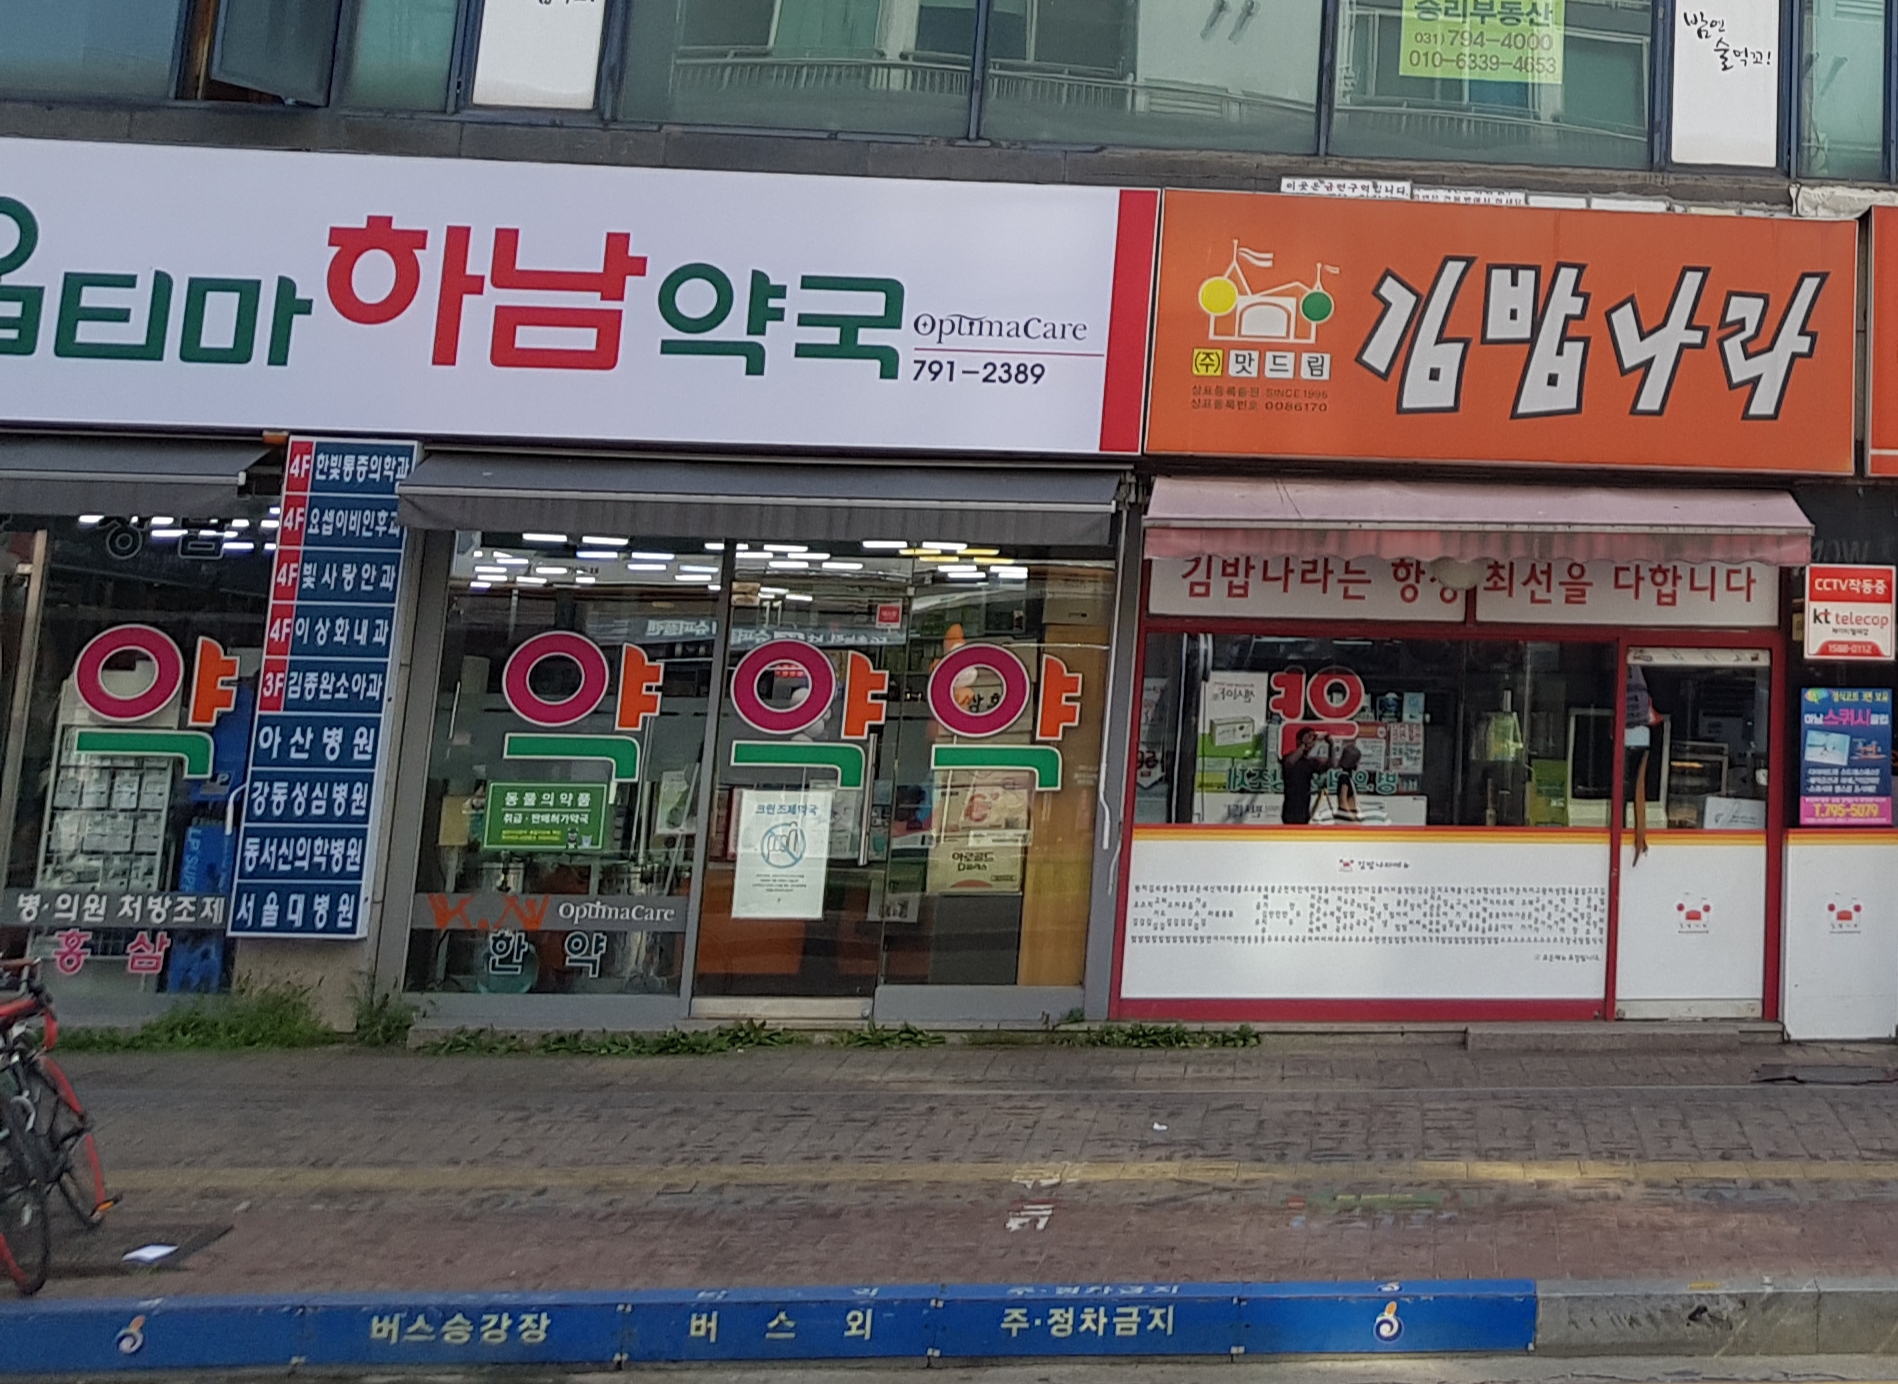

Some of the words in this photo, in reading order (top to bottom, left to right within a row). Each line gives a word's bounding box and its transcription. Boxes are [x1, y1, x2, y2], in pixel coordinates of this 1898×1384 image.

[913, 312, 1089, 345] OptimaCare
[1356, 255, 1831, 420] 김밥나라
[911, 359, 1046, 386] 791-2389
[289, 453, 311, 480] 4F
[283, 505, 305, 533] 4F
[276, 562, 299, 589] 4F
[301, 563, 397, 592] 빛사랑안과
[1180, 554, 1373, 601] 김밥나라는
[1483, 557, 1594, 605] 최선을
[1613, 564, 1757, 608] 다합니다
[269, 616, 292, 642] 4F
[294, 617, 390, 646] 이상화내과
[1812, 608, 1832, 626] kt
[1834, 611, 1889, 630] telecop
[262, 671, 285, 696] 3F
[287, 672, 384, 701] 김종완소아과
[502, 629, 665, 783] 약
[730, 637, 890, 791] 약
[926, 642, 1083, 792] 약
[257, 725, 376, 762] 아산병원
[249, 780, 369, 818] 강동성심병원
[242, 836, 364, 873] 동서신의학병원
[116, 893, 227, 925] 처방조제
[235, 891, 357, 929] 서울대병원
[557, 900, 675, 924] OptimaCare
[370, 1312, 552, 1344] 버스승강장
